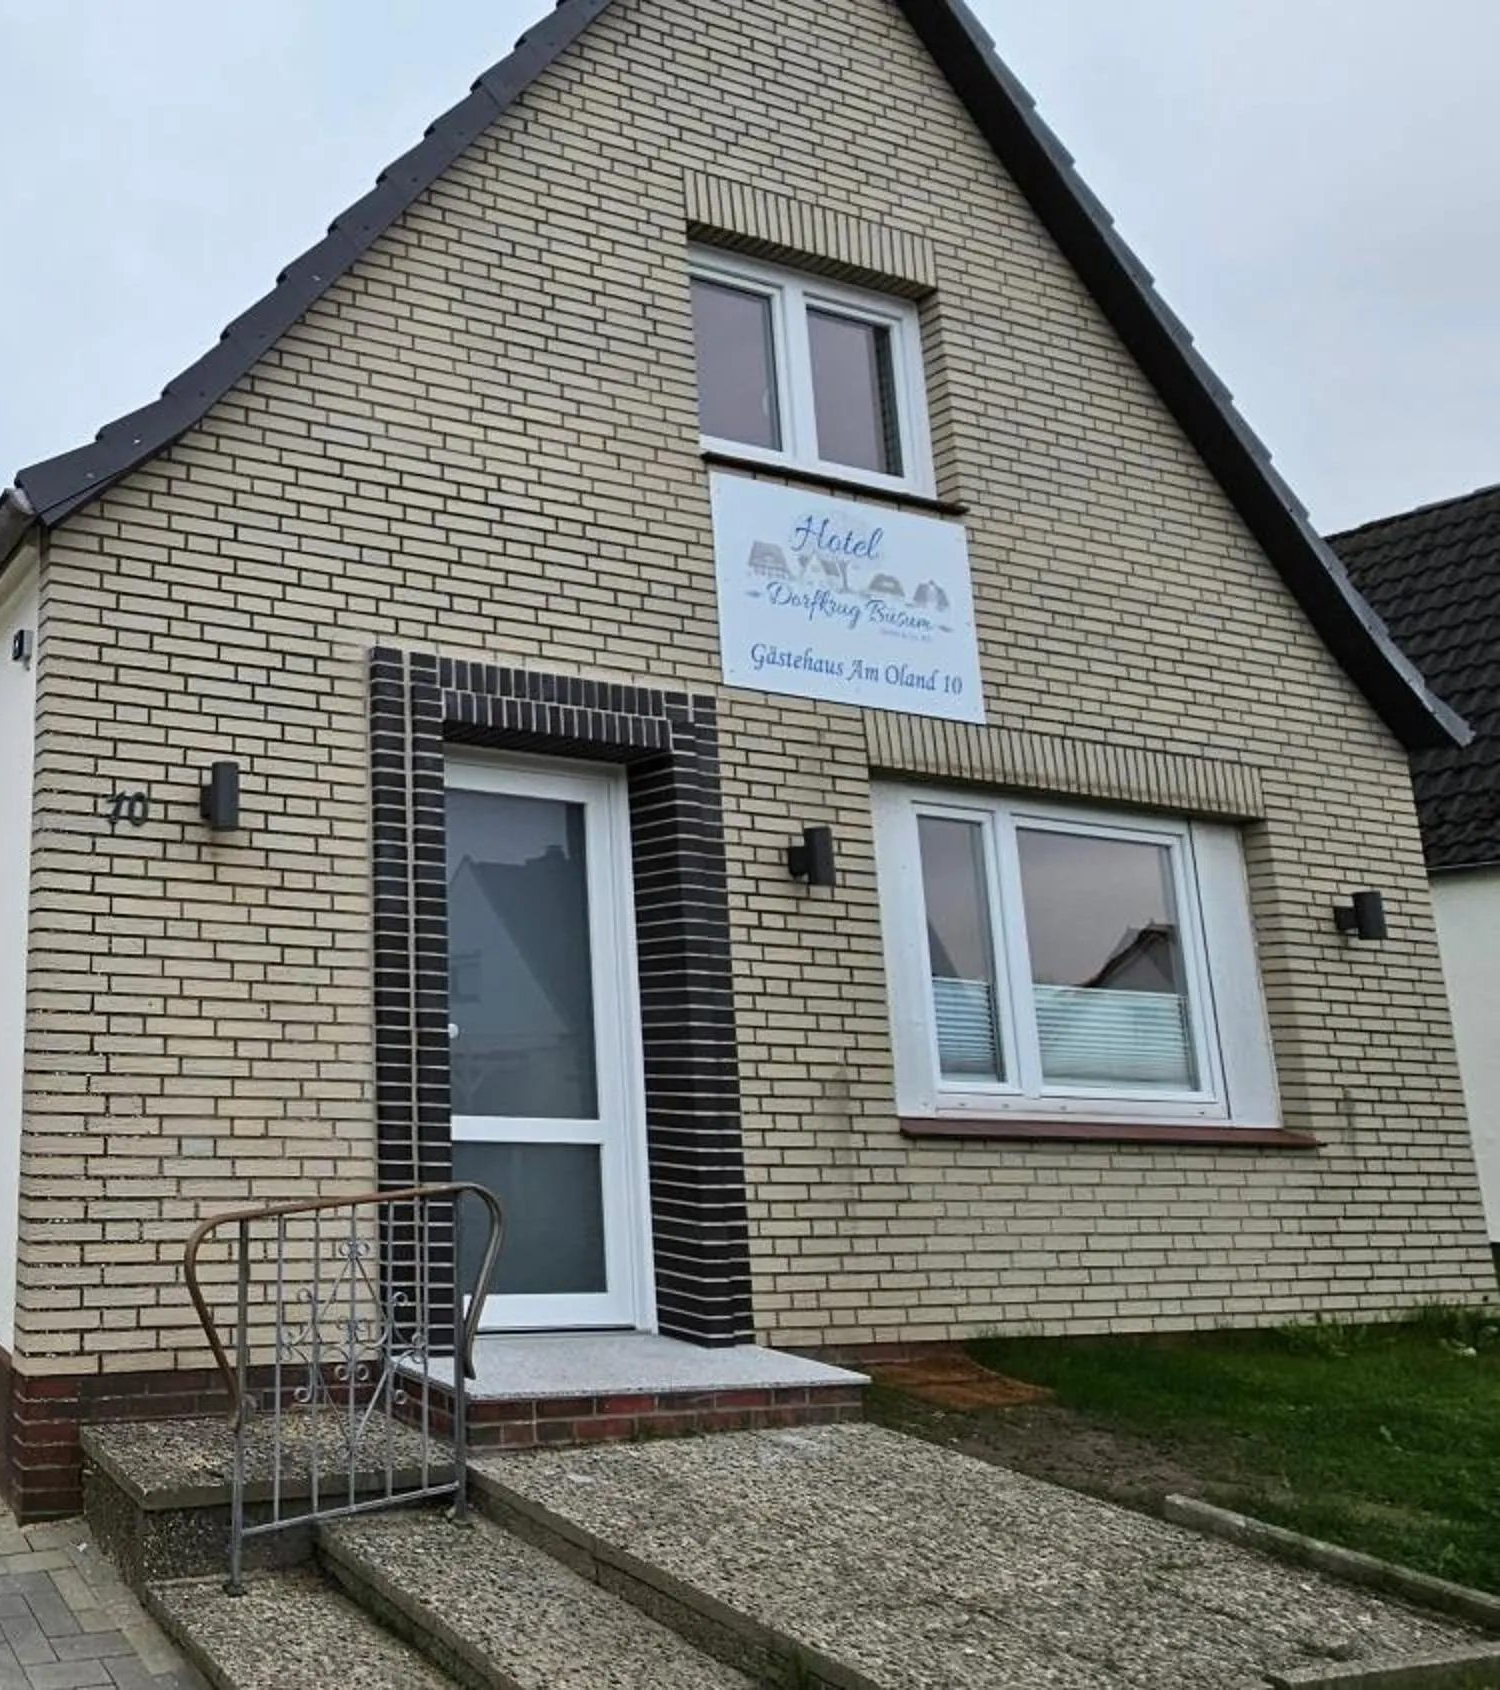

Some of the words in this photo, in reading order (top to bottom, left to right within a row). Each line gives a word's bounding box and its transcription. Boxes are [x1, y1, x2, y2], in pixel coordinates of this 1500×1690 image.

[790, 514, 884, 560] Hotel
[765, 580, 861, 629] Dorfkrug
[750, 643, 844, 677] Gästehaus
[846, 658, 880, 681] Am
[885, 664, 938, 691] Oland
[942, 673, 963, 695] 10
[107, 790, 148, 827] 10
